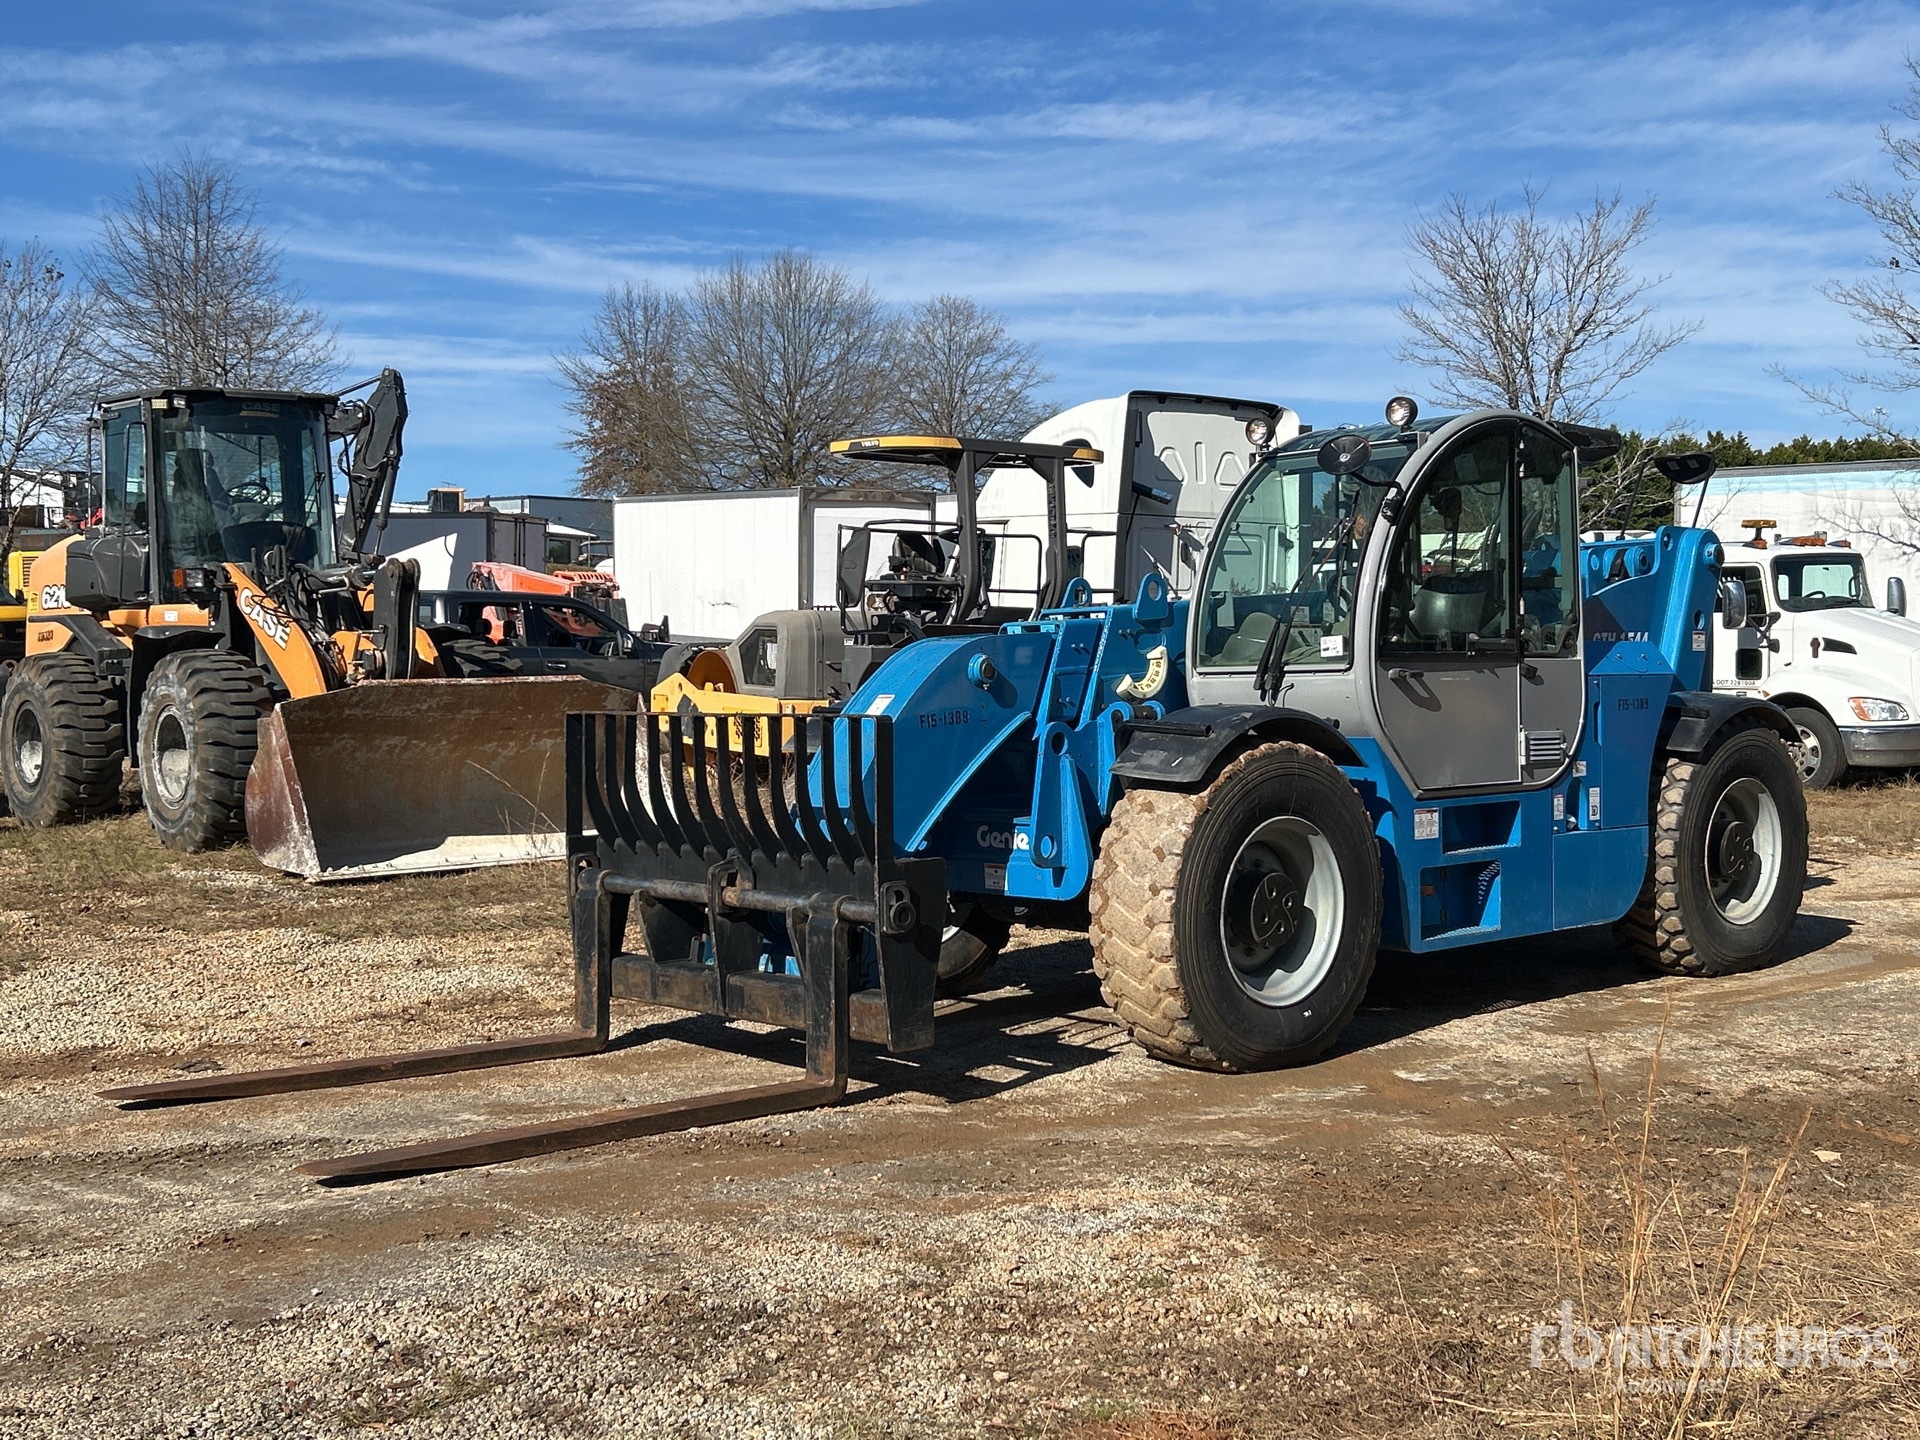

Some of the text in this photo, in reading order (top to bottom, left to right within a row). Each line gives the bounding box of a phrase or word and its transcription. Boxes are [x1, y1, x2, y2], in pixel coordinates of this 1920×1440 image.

[242, 402, 281, 412] CASE
[240, 587, 291, 651] CASE
[977, 825, 1029, 850] Genie
